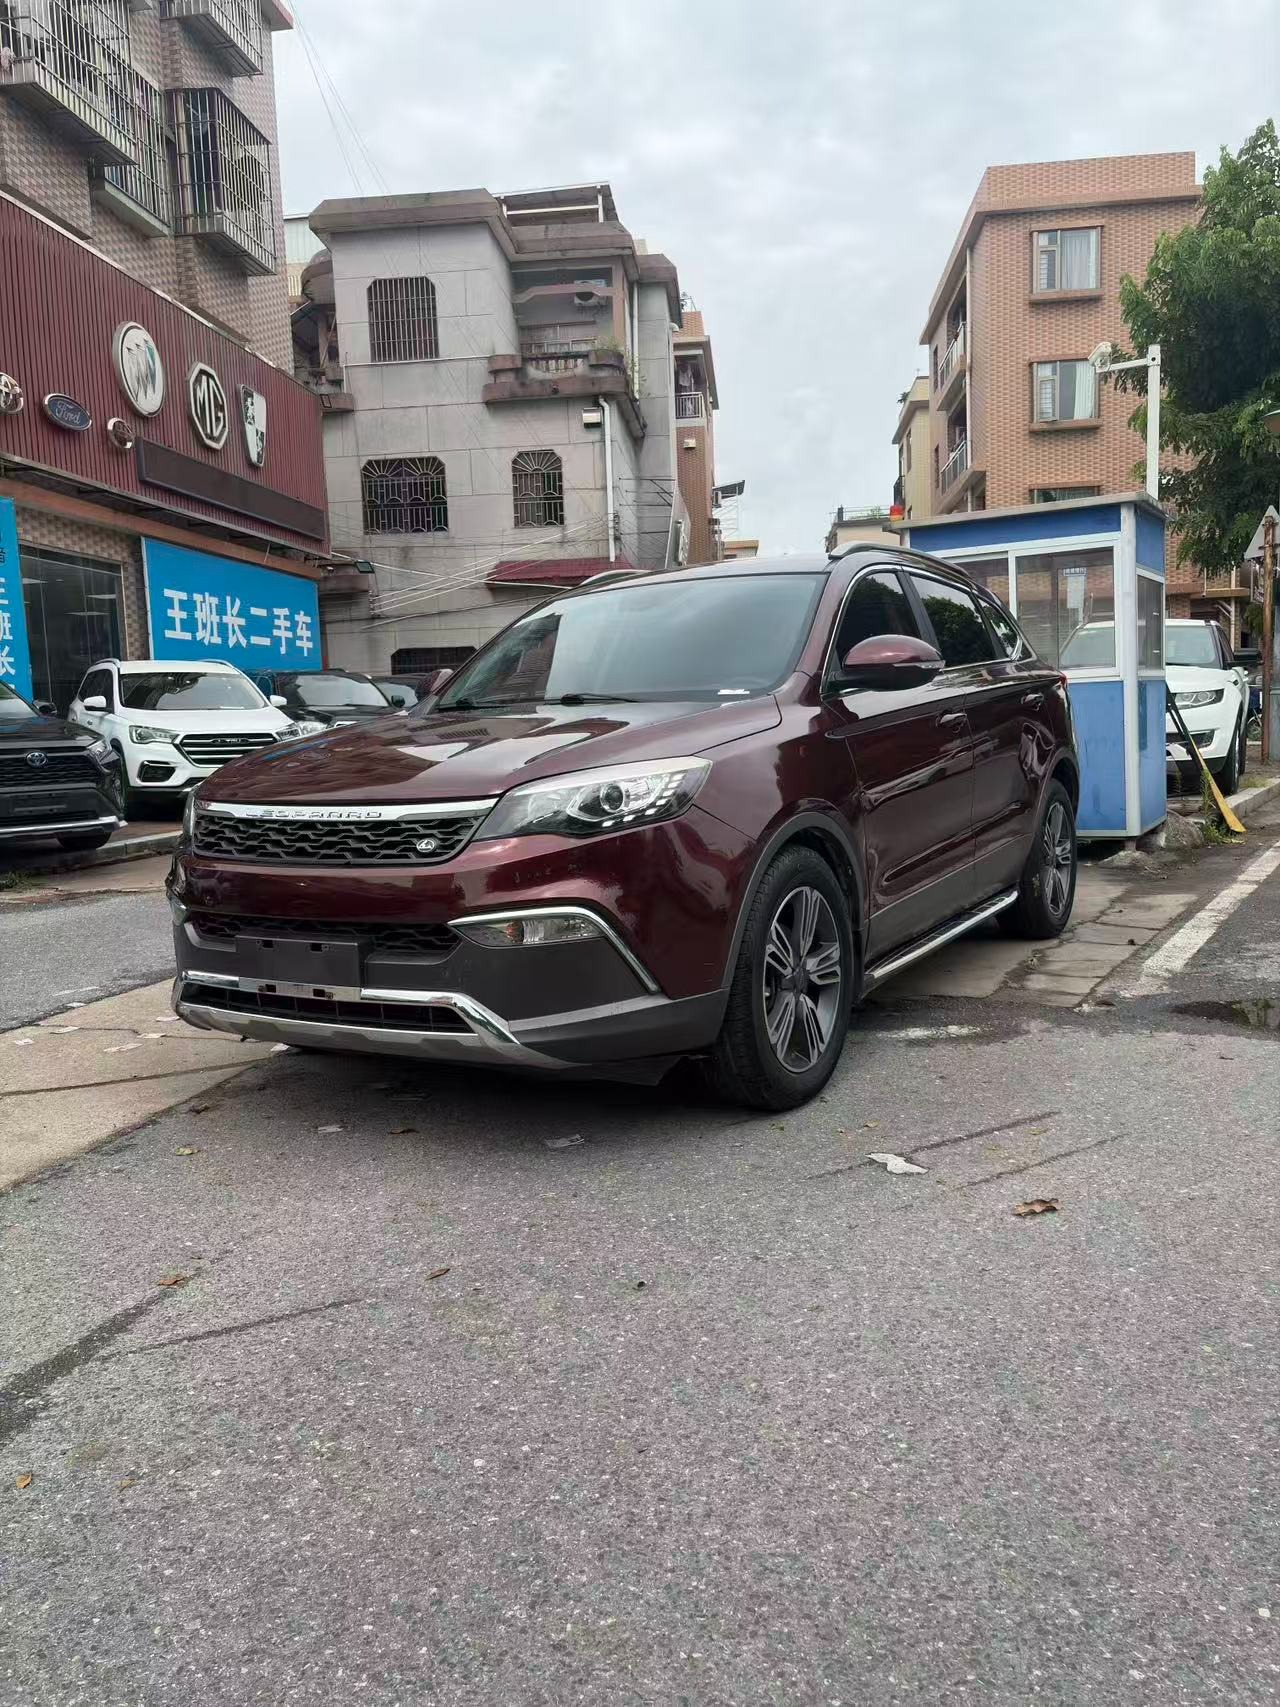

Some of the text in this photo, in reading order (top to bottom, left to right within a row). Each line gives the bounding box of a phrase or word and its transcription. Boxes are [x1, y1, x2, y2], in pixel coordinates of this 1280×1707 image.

[55, 400, 81, 424] Ford
[197, 375, 224, 437] MG
[163, 588, 313, 657] 王班长二手车
